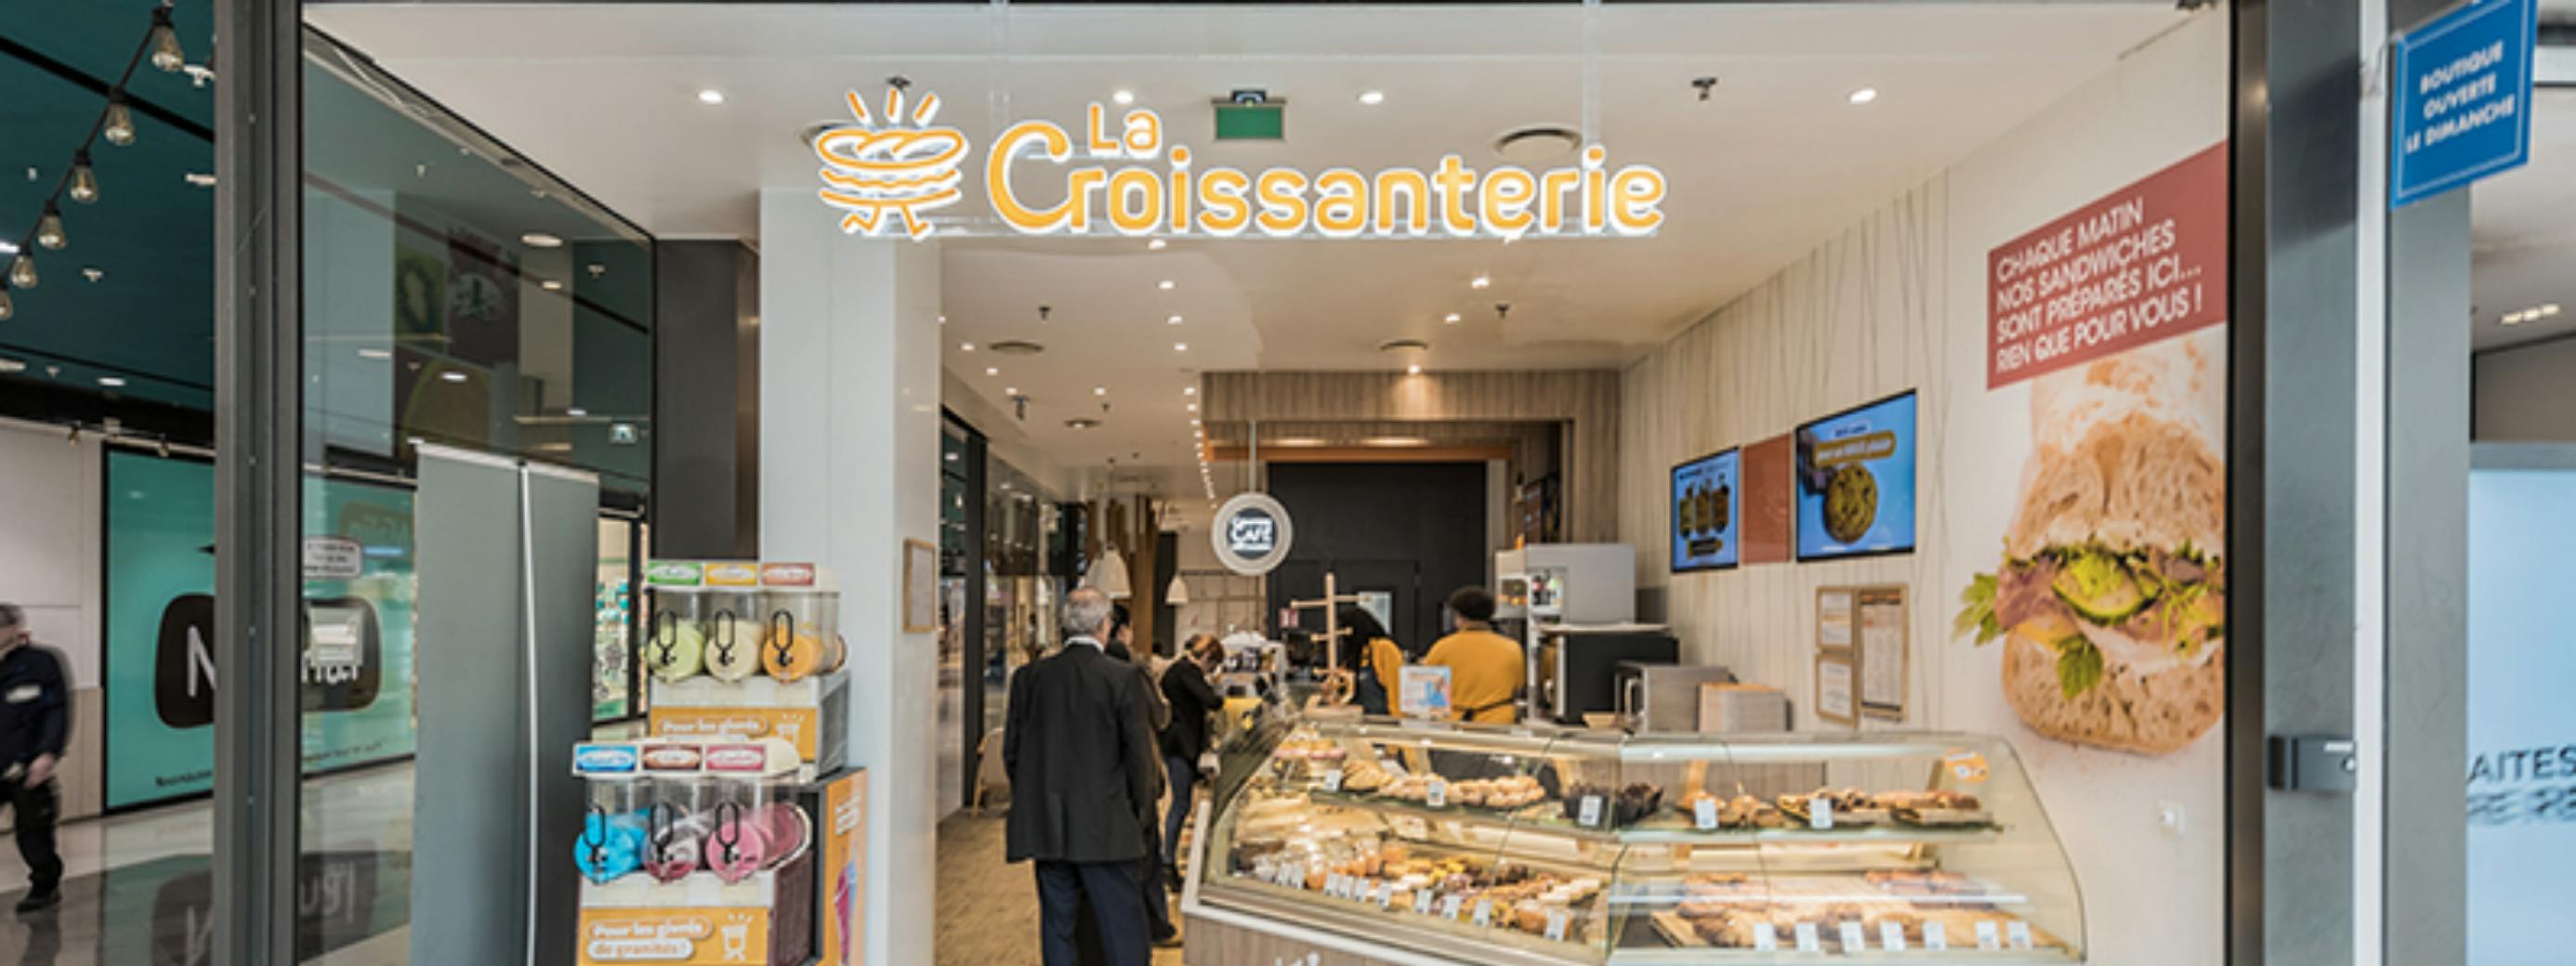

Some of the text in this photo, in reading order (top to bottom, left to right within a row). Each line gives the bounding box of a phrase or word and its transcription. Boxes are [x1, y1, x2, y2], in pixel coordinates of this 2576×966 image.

[2420, 40, 2504, 95] BOUTIQUE
[2424, 72, 2496, 120] OUVERTE
[1089, 106, 1160, 153] La
[2407, 94, 2515, 154] LE DIMANCHE
[987, 123, 1666, 236] Croissanterie
[1998, 196, 2144, 282] CHAQUE MATIN
[1998, 218, 2175, 312] NOS SANDWICHES
[1997, 340, 2031, 372] RIEN
[2035, 326, 2070, 360] QUE
[2074, 307, 2127, 350] POUR
[2130, 287, 2188, 331] VOUS
[1998, 254, 2201, 344] SONT PRÉPARÉS ICI...
[595, 923, 629, 936] Pour
